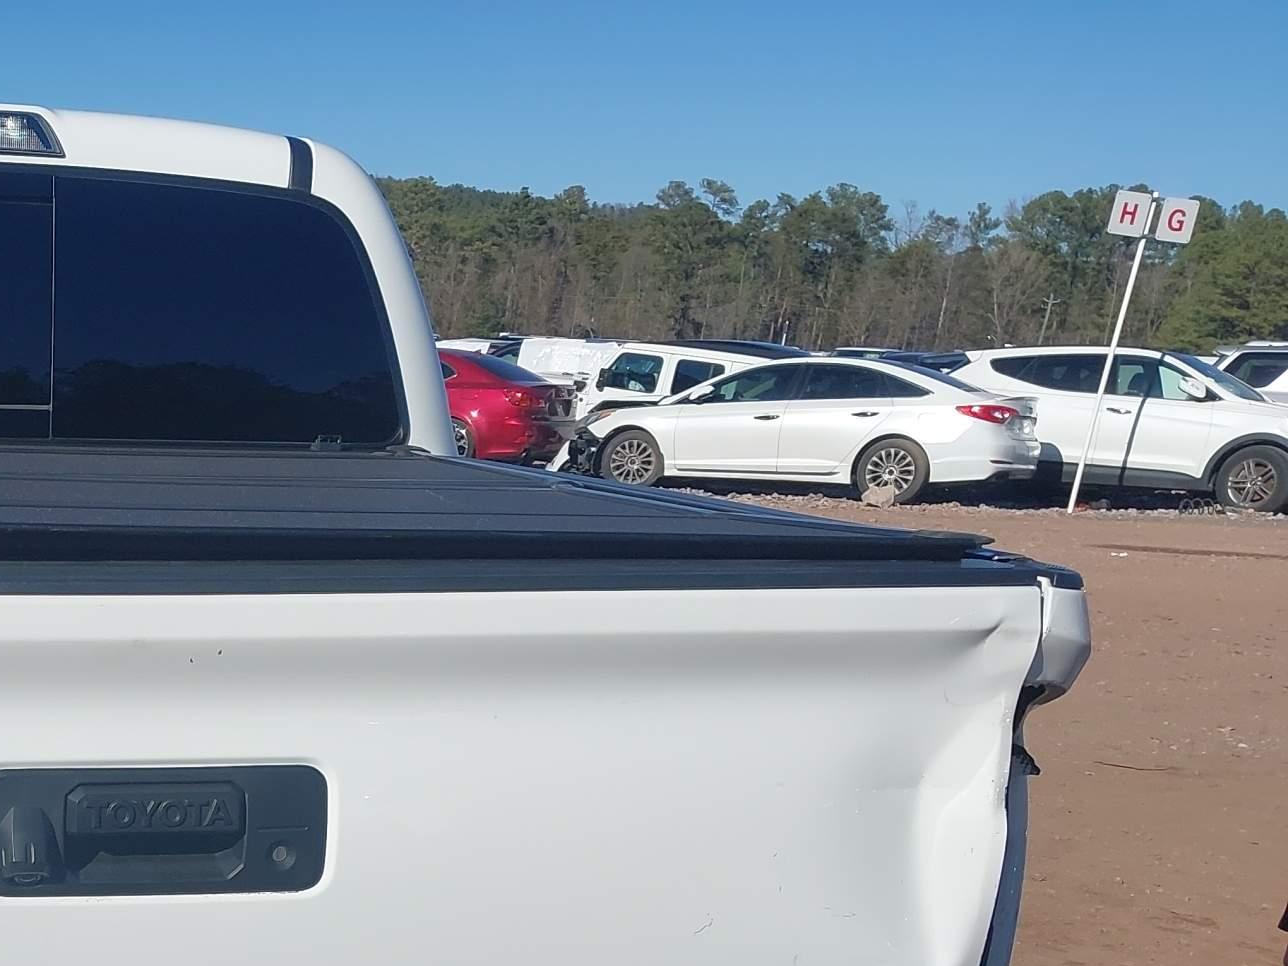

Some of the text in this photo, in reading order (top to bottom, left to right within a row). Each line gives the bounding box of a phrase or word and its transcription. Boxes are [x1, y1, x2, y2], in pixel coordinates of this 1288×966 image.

[1119, 202, 1139, 225] H
[1167, 208, 1187, 232] G
[86, 799, 233, 829] TOYOTA
